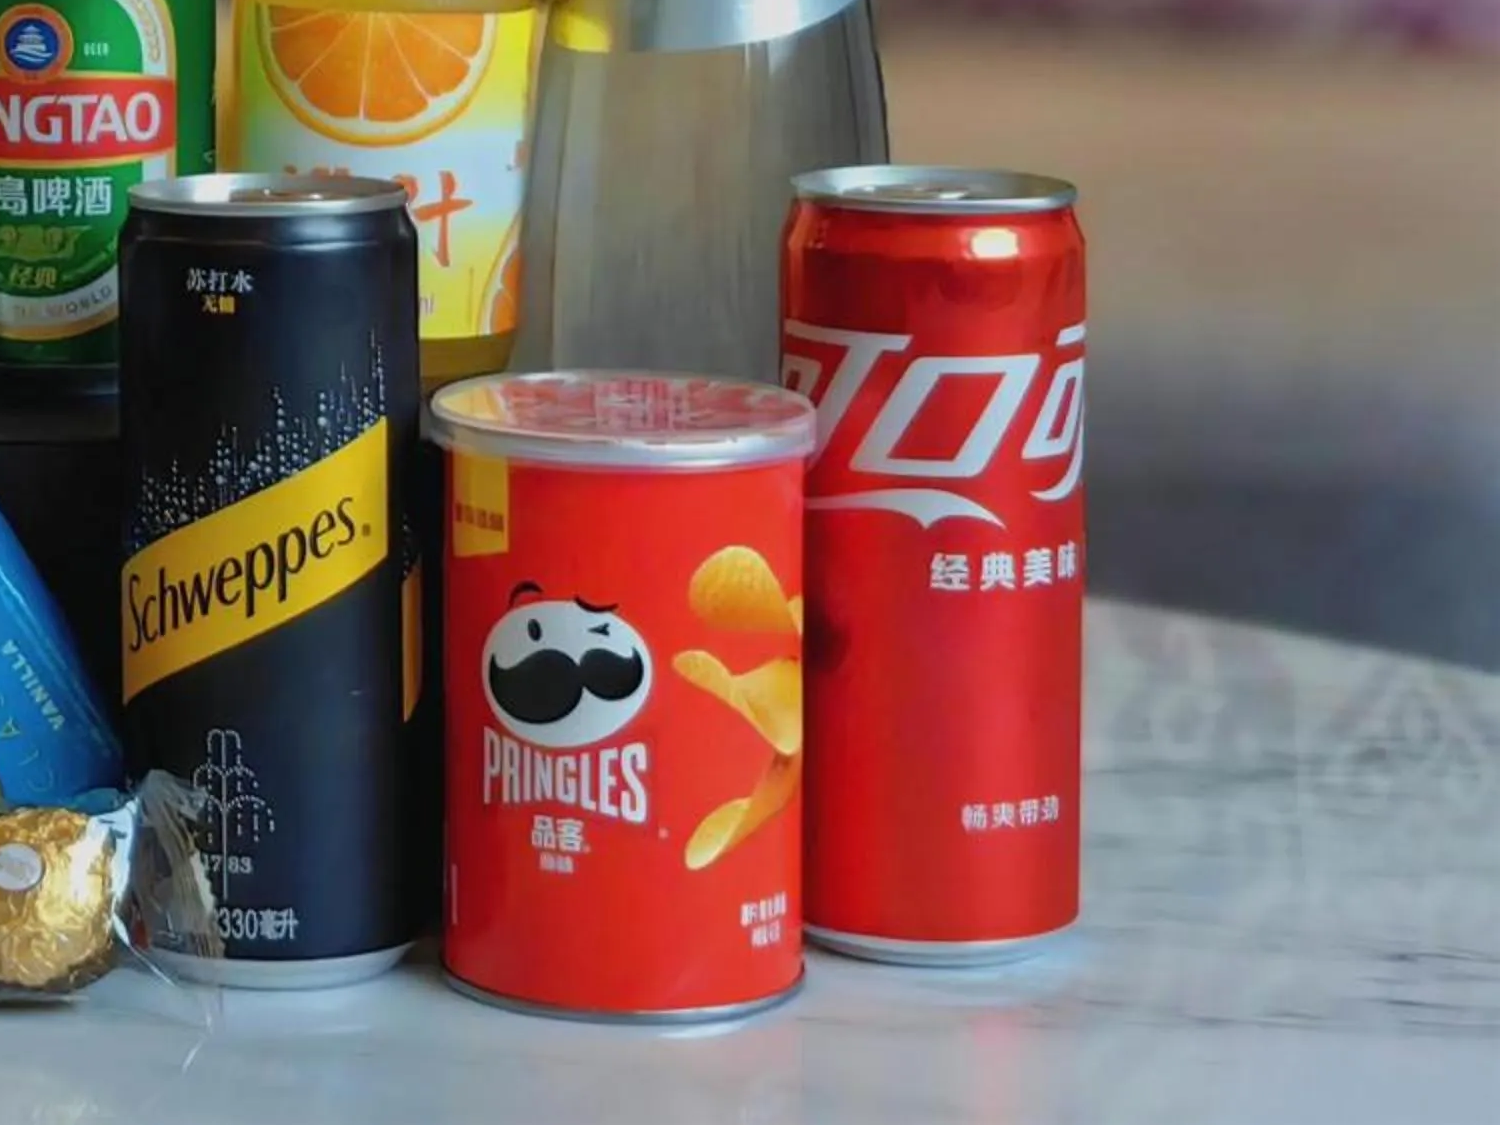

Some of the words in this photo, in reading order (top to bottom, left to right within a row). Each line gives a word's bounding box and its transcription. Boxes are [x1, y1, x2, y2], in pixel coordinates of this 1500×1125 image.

[9, 263, 58, 289] 经典
[186, 267, 254, 293] 苏打水
[129, 496, 354, 653] Schweppes
[930, 539, 1076, 592] 经典美味
[1, 638, 67, 733] VANILLA
[483, 726, 648, 824] PRINGLES
[531, 815, 584, 852] 品客
